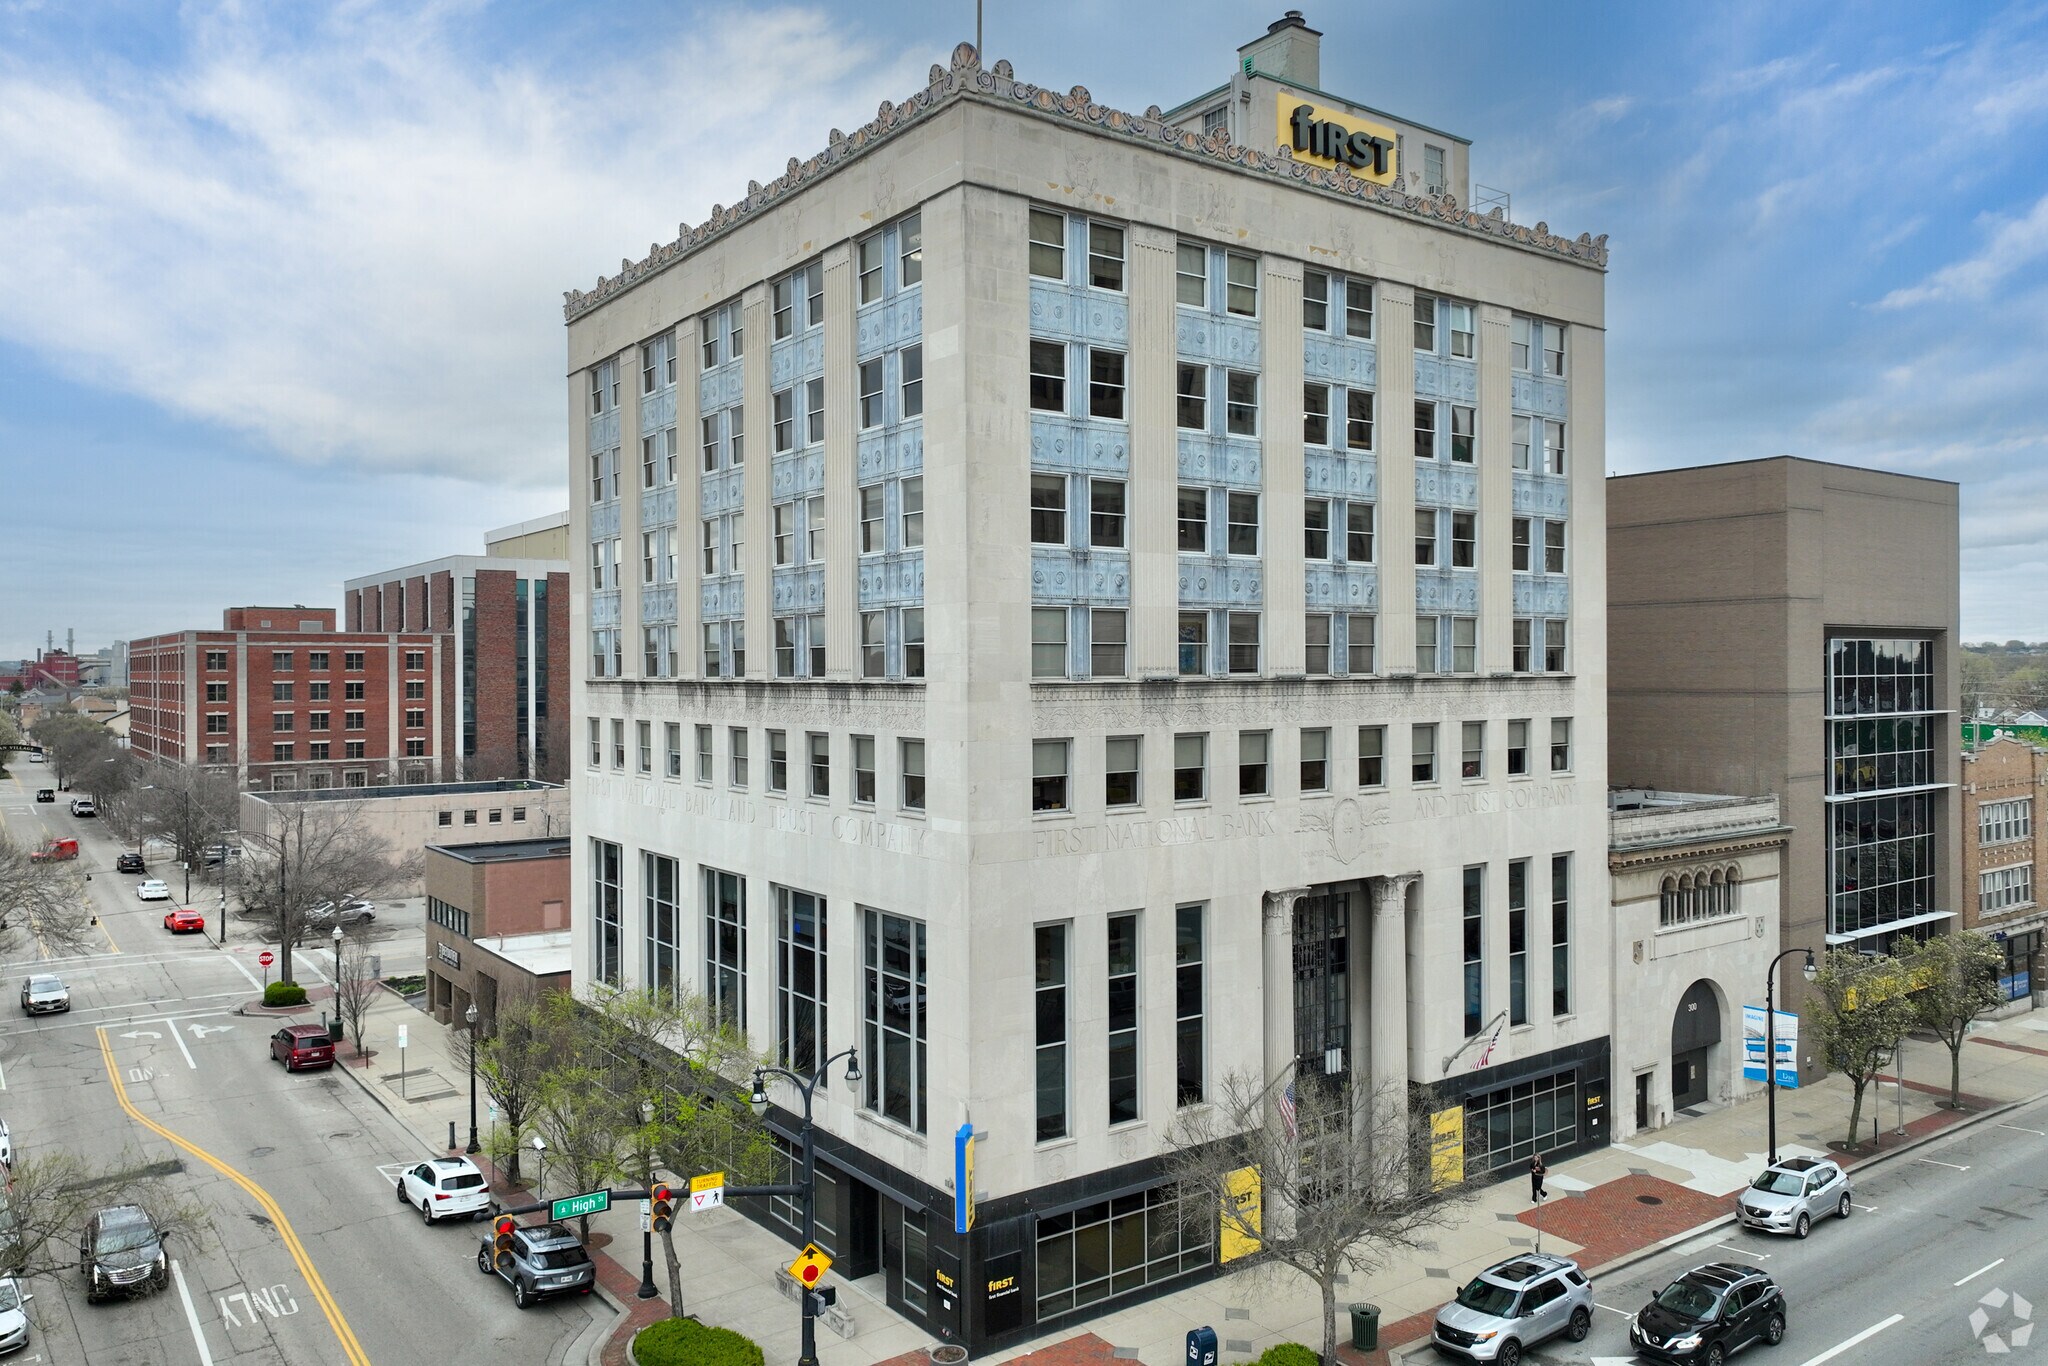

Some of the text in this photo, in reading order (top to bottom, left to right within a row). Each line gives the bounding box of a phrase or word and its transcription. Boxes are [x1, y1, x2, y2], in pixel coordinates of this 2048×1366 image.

[623, 782, 675, 809] NATIONAL
[685, 791, 718, 815] BANK
[729, 799, 756, 824] AND
[769, 805, 816, 835] TRUST
[832, 815, 927, 855] COMPANY
[1033, 783, 1578, 858] FIRST NATIONAL BANK AND TRUST COMPANY
[1688, 1002, 1698, 1012] 300
[696, 1176, 718, 1184] TURNING
[696, 1182, 717, 1190] TRAFFIC
[572, 1198, 596, 1213] High
[219, 1284, 299, 1330] ONLY
